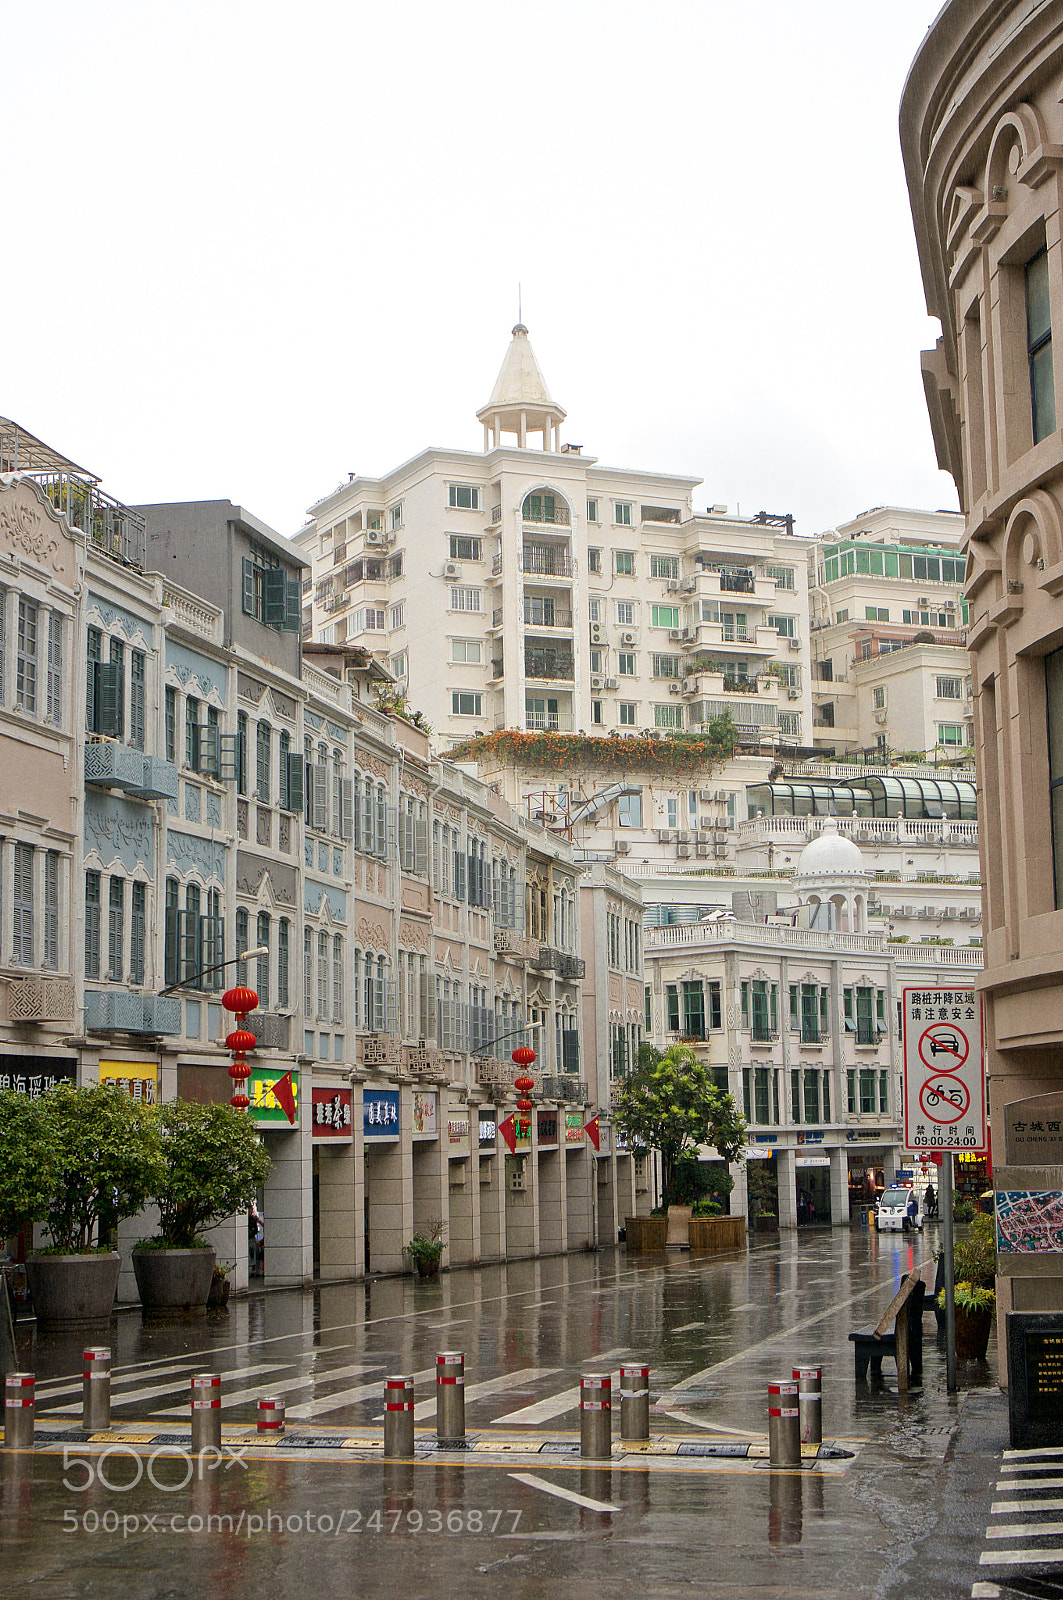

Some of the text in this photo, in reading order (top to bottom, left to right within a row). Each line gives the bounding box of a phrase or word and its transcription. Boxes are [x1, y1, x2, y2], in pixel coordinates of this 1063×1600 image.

[911, 992, 975, 1005] 路桩升降区域
[911, 1007, 975, 1020] 请注意安全
[916, 1125, 975, 1136] 禁行时间
[914, 1136, 977, 1146] 09:00-24:00
